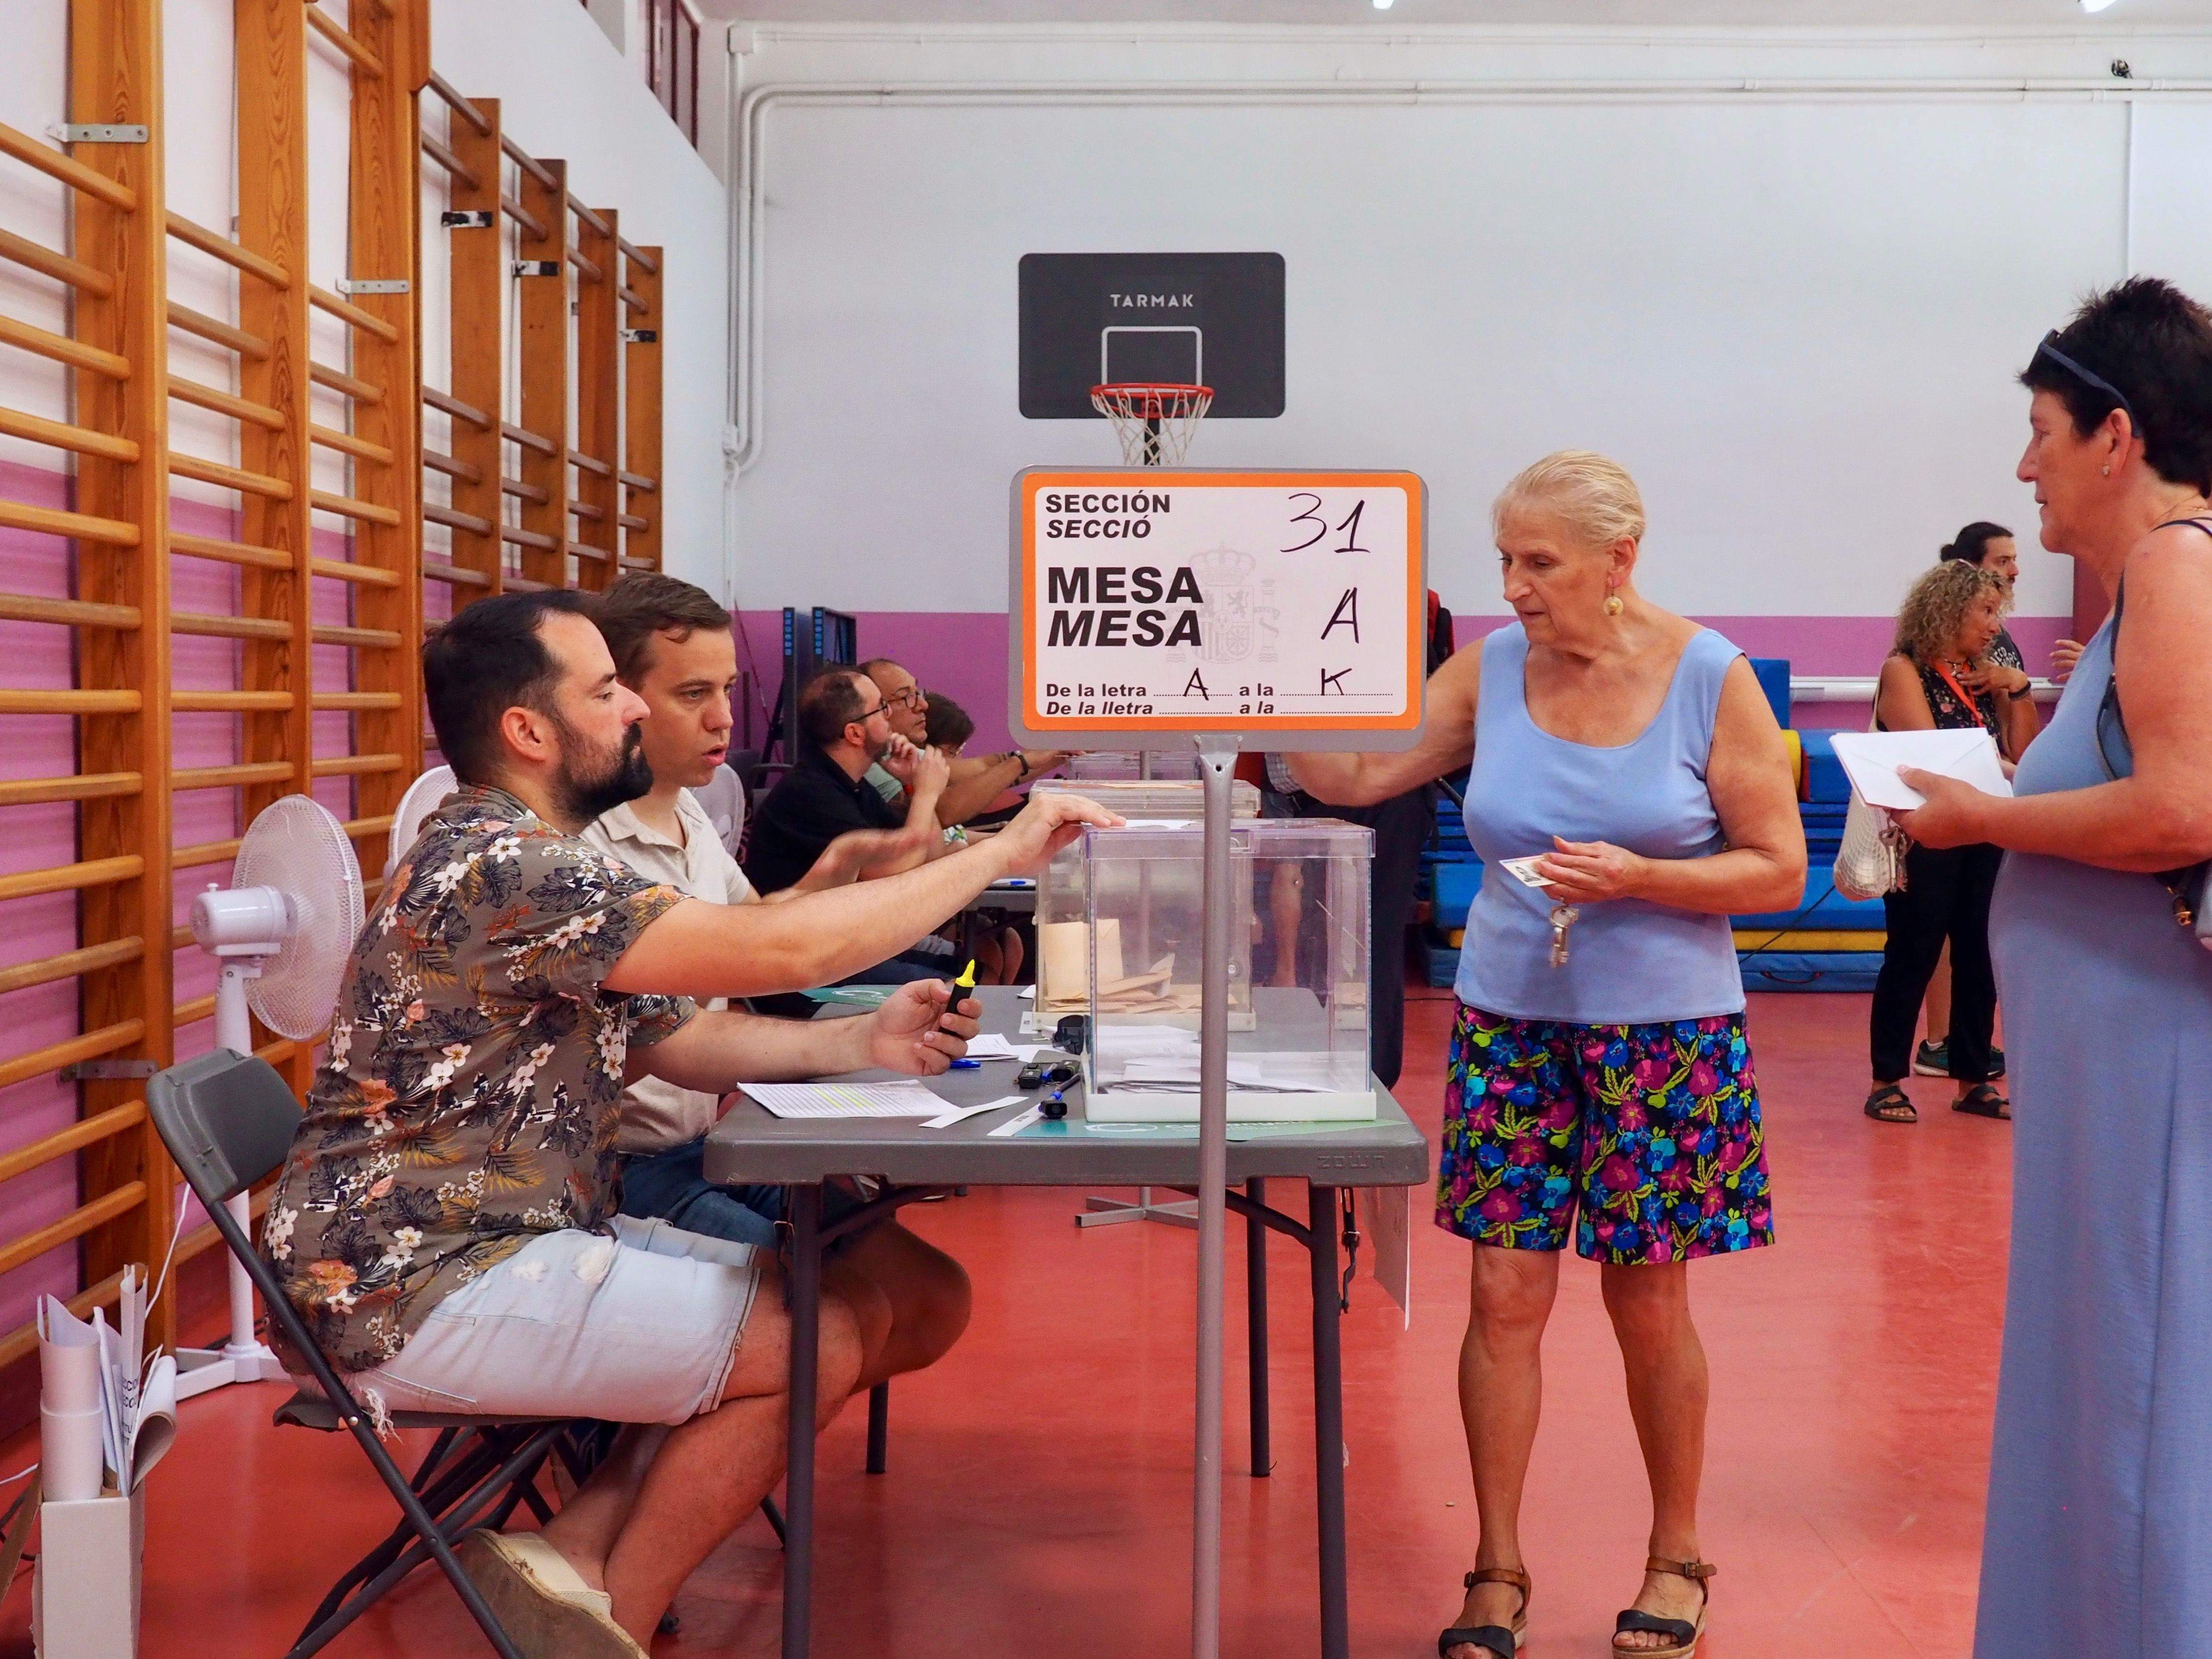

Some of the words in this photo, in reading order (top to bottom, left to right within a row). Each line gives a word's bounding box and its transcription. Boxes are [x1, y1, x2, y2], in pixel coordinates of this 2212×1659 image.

[1110, 294, 1194, 307] TARMAK
[1045, 490, 1171, 514] SECCIÓN
[1046, 515, 1151, 538] SECCIÓ
[1280, 493, 1371, 553] 31
[1048, 566, 1204, 604] MESA
[1047, 609, 1202, 647] MESA
[1321, 587, 1360, 644] A
[1046, 683, 1071, 697] De
[1078, 683, 1095, 697] la
[1102, 683, 1147, 697] letra
[1182, 667, 1210, 701] A
[1239, 686, 1250, 696] a
[1257, 683, 1274, 696] la
[1321, 668, 1352, 696] K
[1046, 701, 1071, 715] De
[1078, 701, 1096, 715] la
[1102, 701, 1153, 715] lletra
[1239, 704, 1251, 714] a
[1257, 701, 1274, 714] la
